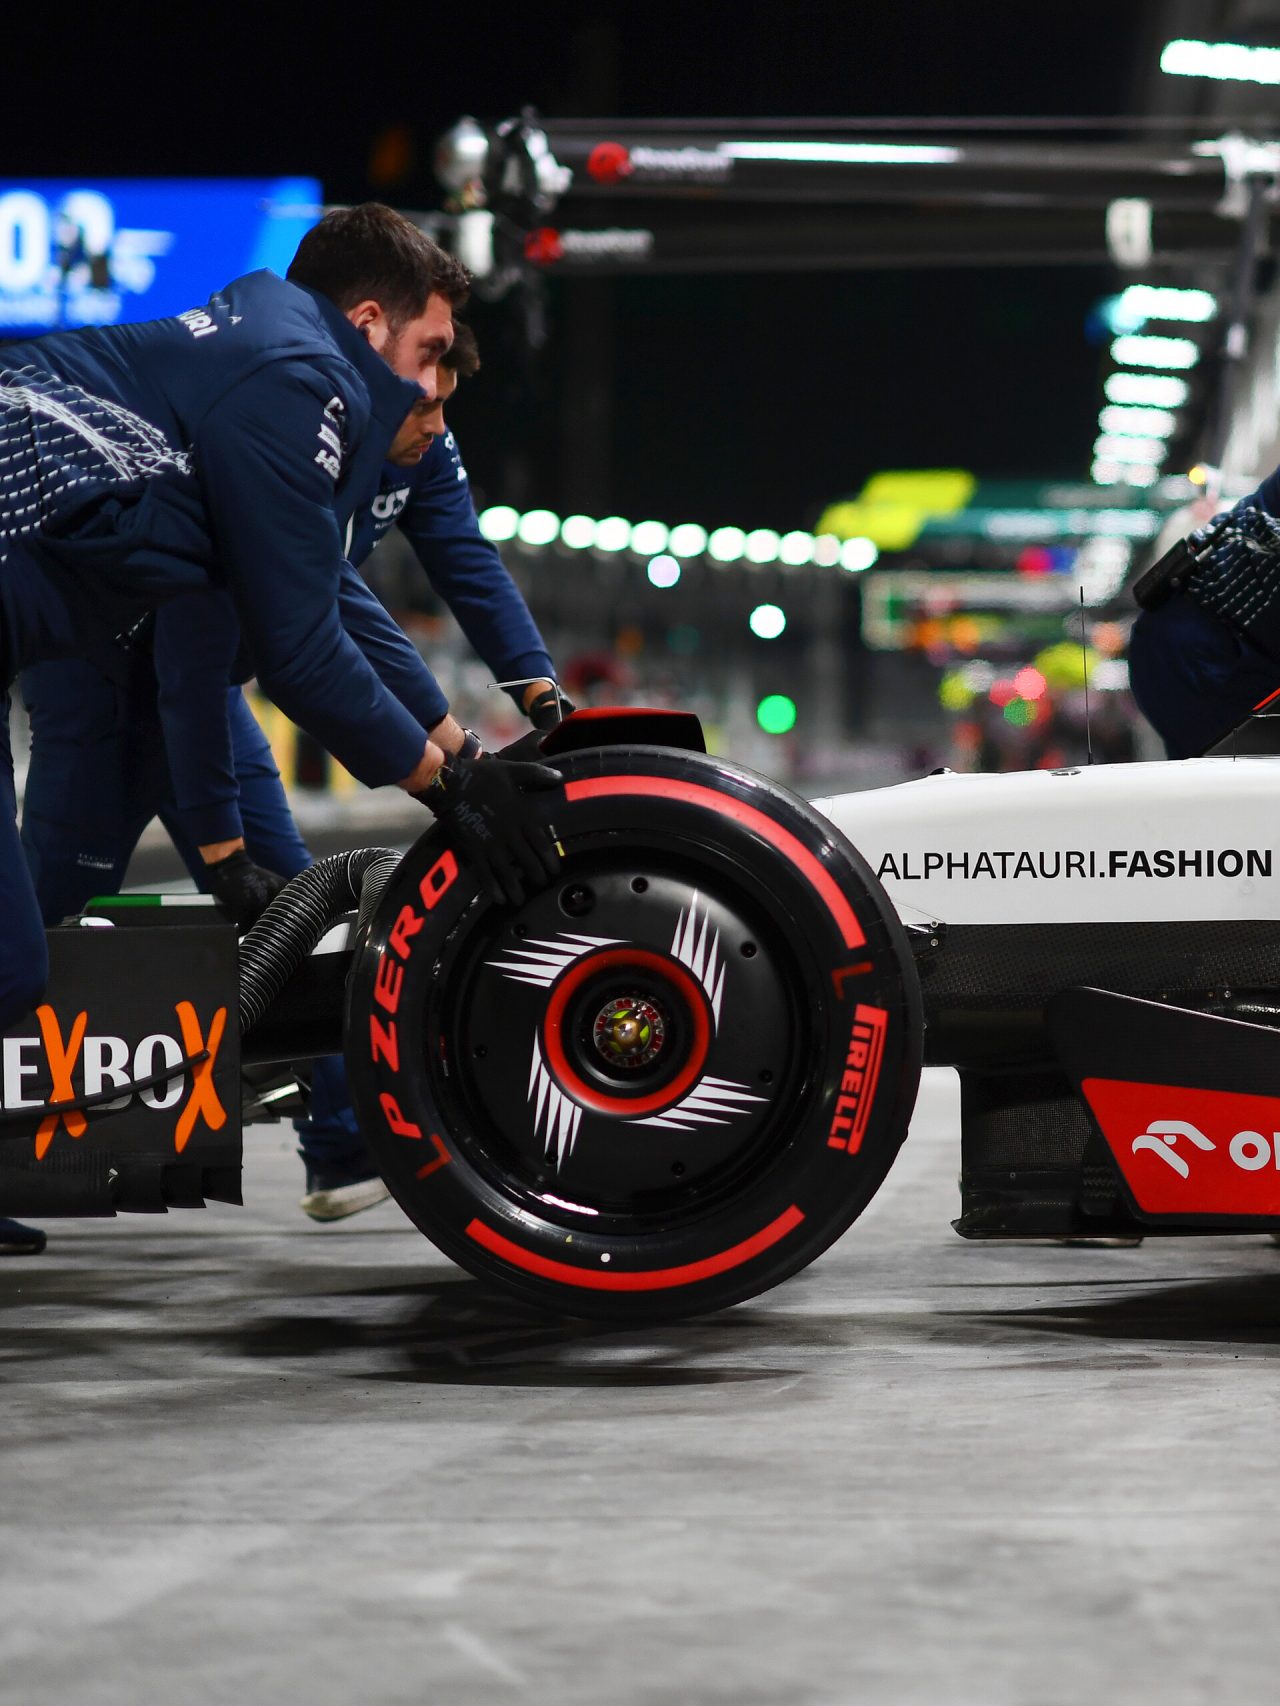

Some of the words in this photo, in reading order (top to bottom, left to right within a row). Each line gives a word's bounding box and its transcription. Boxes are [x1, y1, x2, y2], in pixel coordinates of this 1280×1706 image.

[876, 849, 1273, 881] ALPHATAURI.FASHION
[369, 849, 459, 1073] ZERO
[0, 1001, 228, 1161] EXBOX
[827, 1003, 888, 1155] PIRELLI
